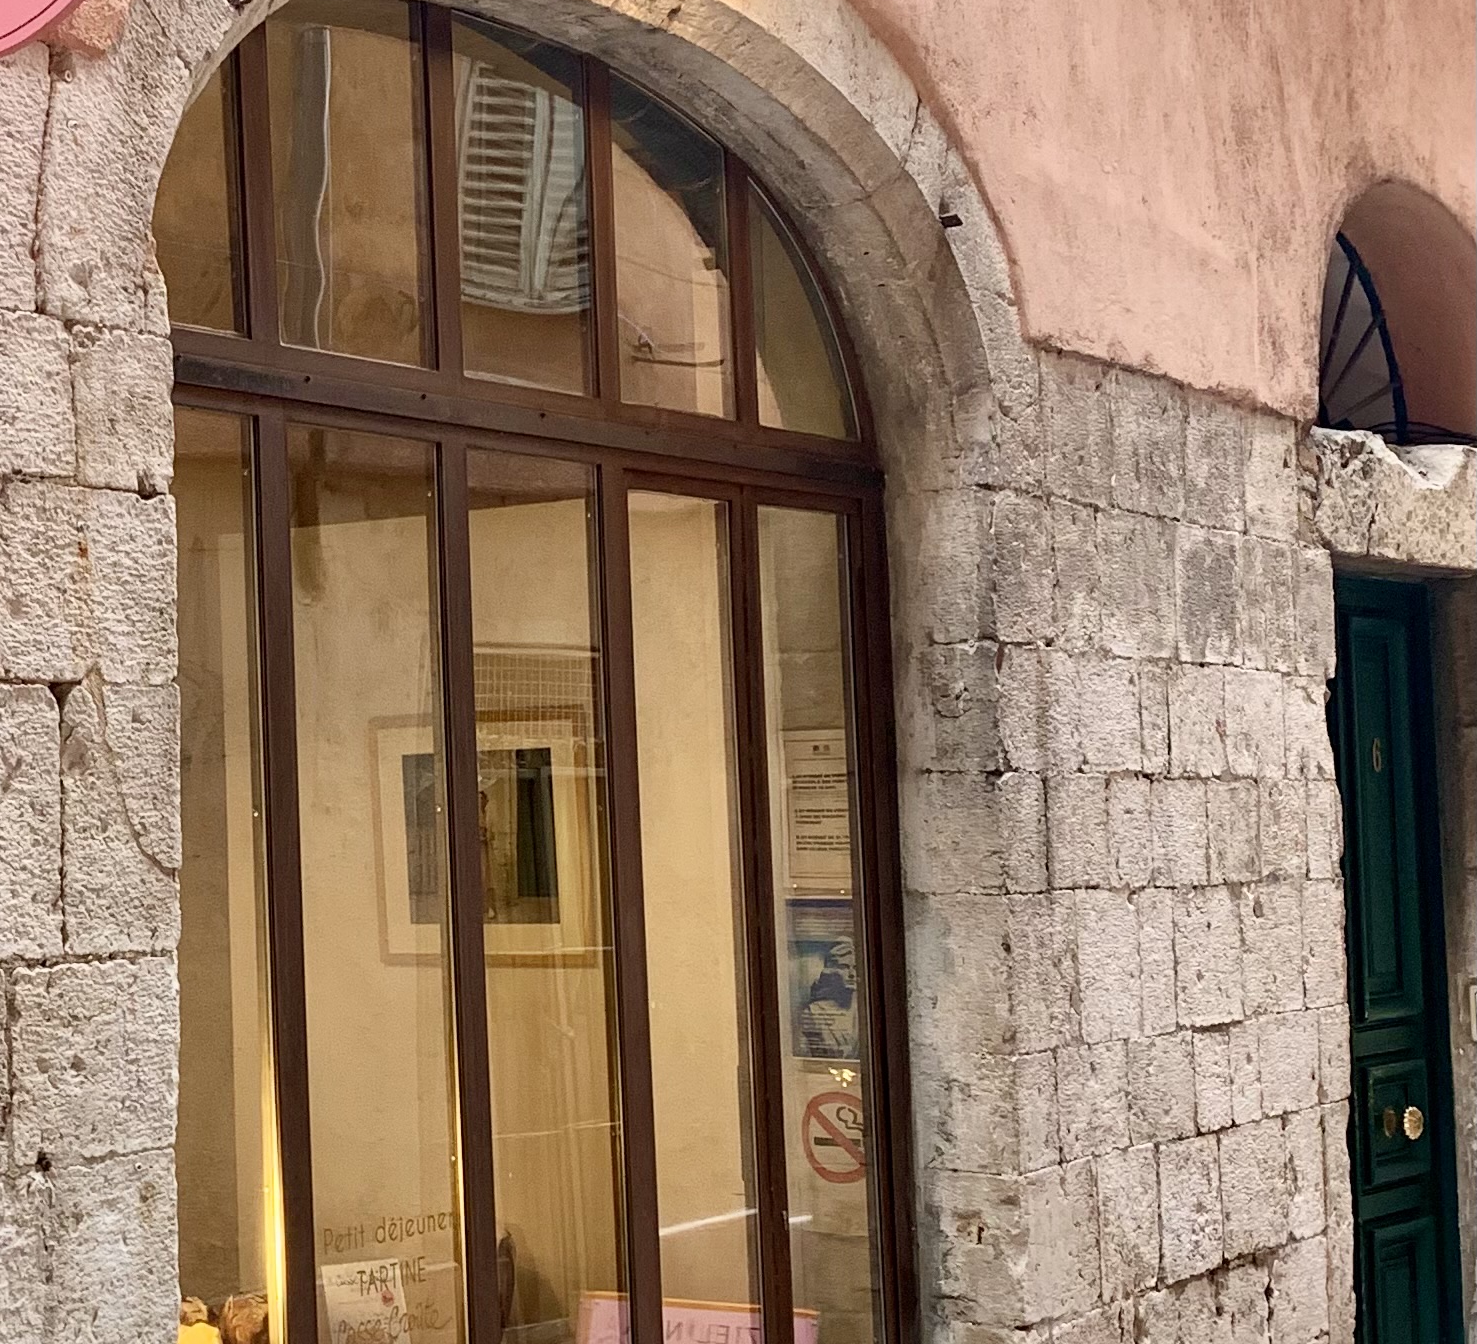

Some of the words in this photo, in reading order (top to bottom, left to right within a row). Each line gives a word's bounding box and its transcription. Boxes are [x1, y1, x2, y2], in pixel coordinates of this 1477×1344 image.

[1371, 736, 1383, 774] 6
[323, 1223, 365, 1256] Petit
[356, 1255, 427, 1297] TARTINE
